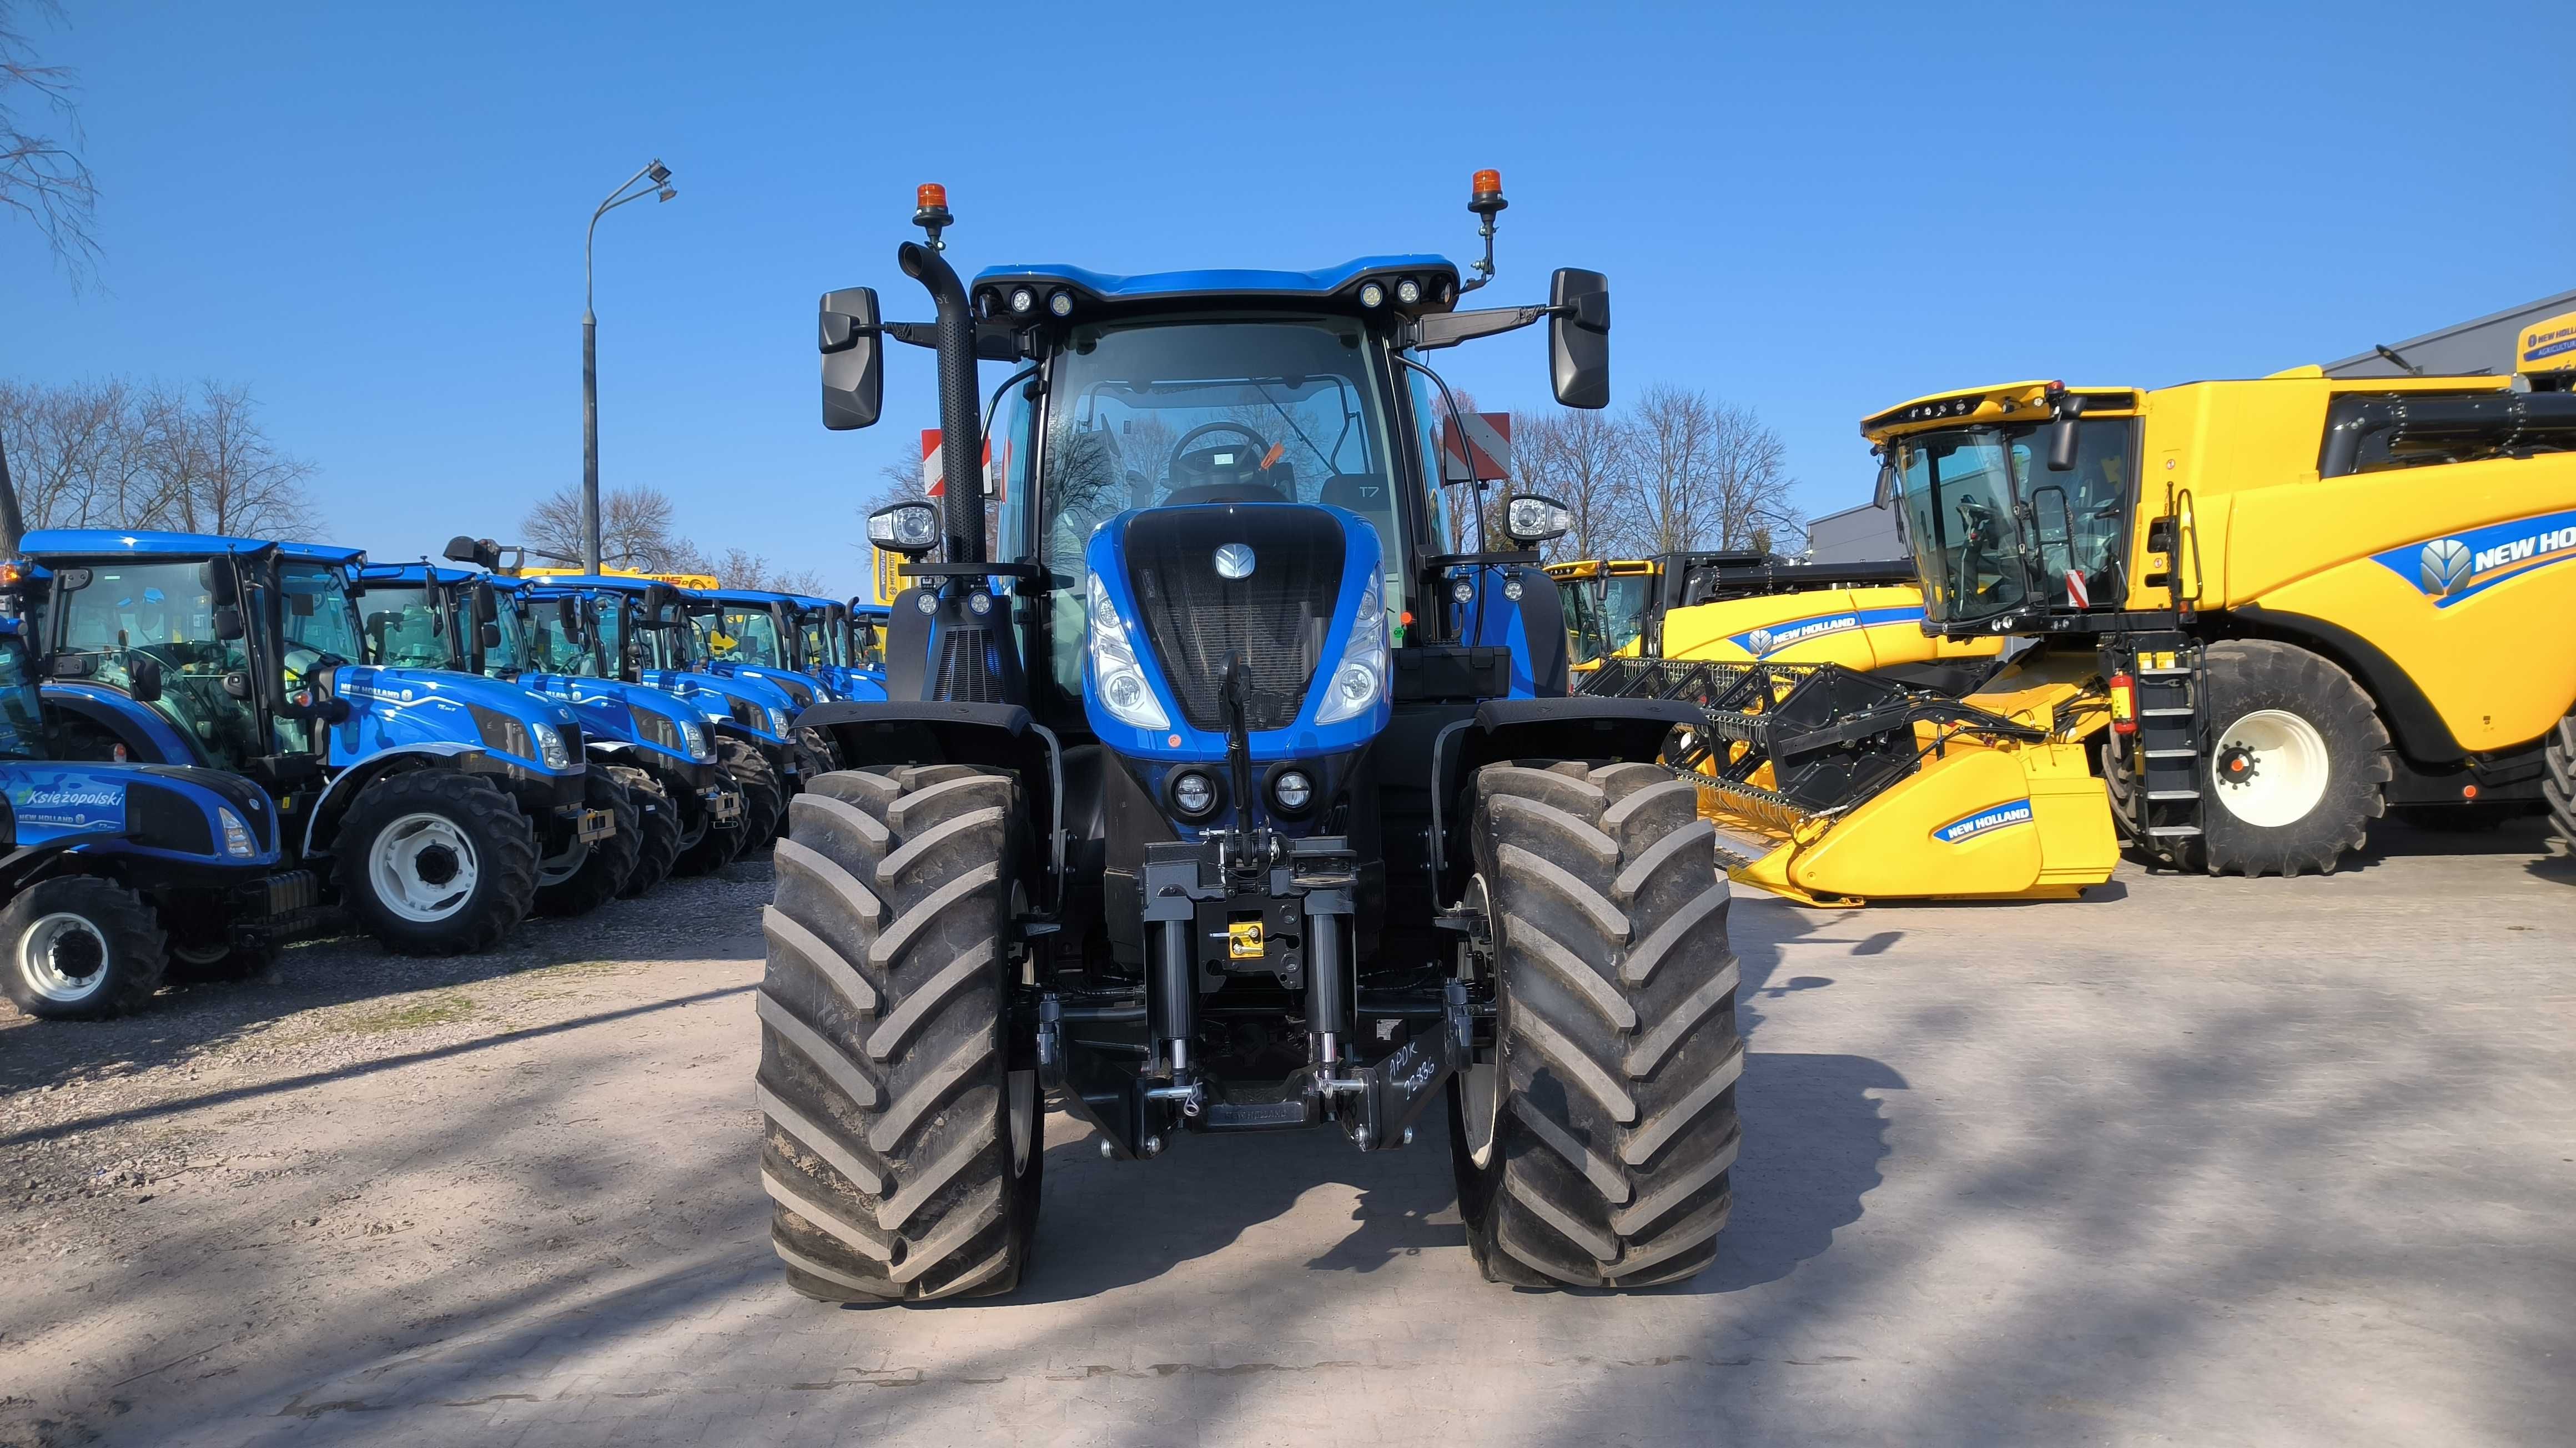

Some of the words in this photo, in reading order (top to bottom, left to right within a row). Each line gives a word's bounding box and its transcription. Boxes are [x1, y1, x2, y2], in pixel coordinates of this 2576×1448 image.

[2538, 331, 2555, 343] NEW
[1359, 486, 1379, 497] T7
[2475, 536, 2536, 572] NEW
[1773, 628, 1800, 644] NEW
[1802, 617, 1855, 636] HOLLAND
[340, 683, 361, 692] NEW
[362, 686, 400, 699] HOLLAND
[27, 791, 124, 806] Księżopolski
[1948, 821, 1974, 838] NEW
[1975, 808, 2029, 829] HOLLAND
